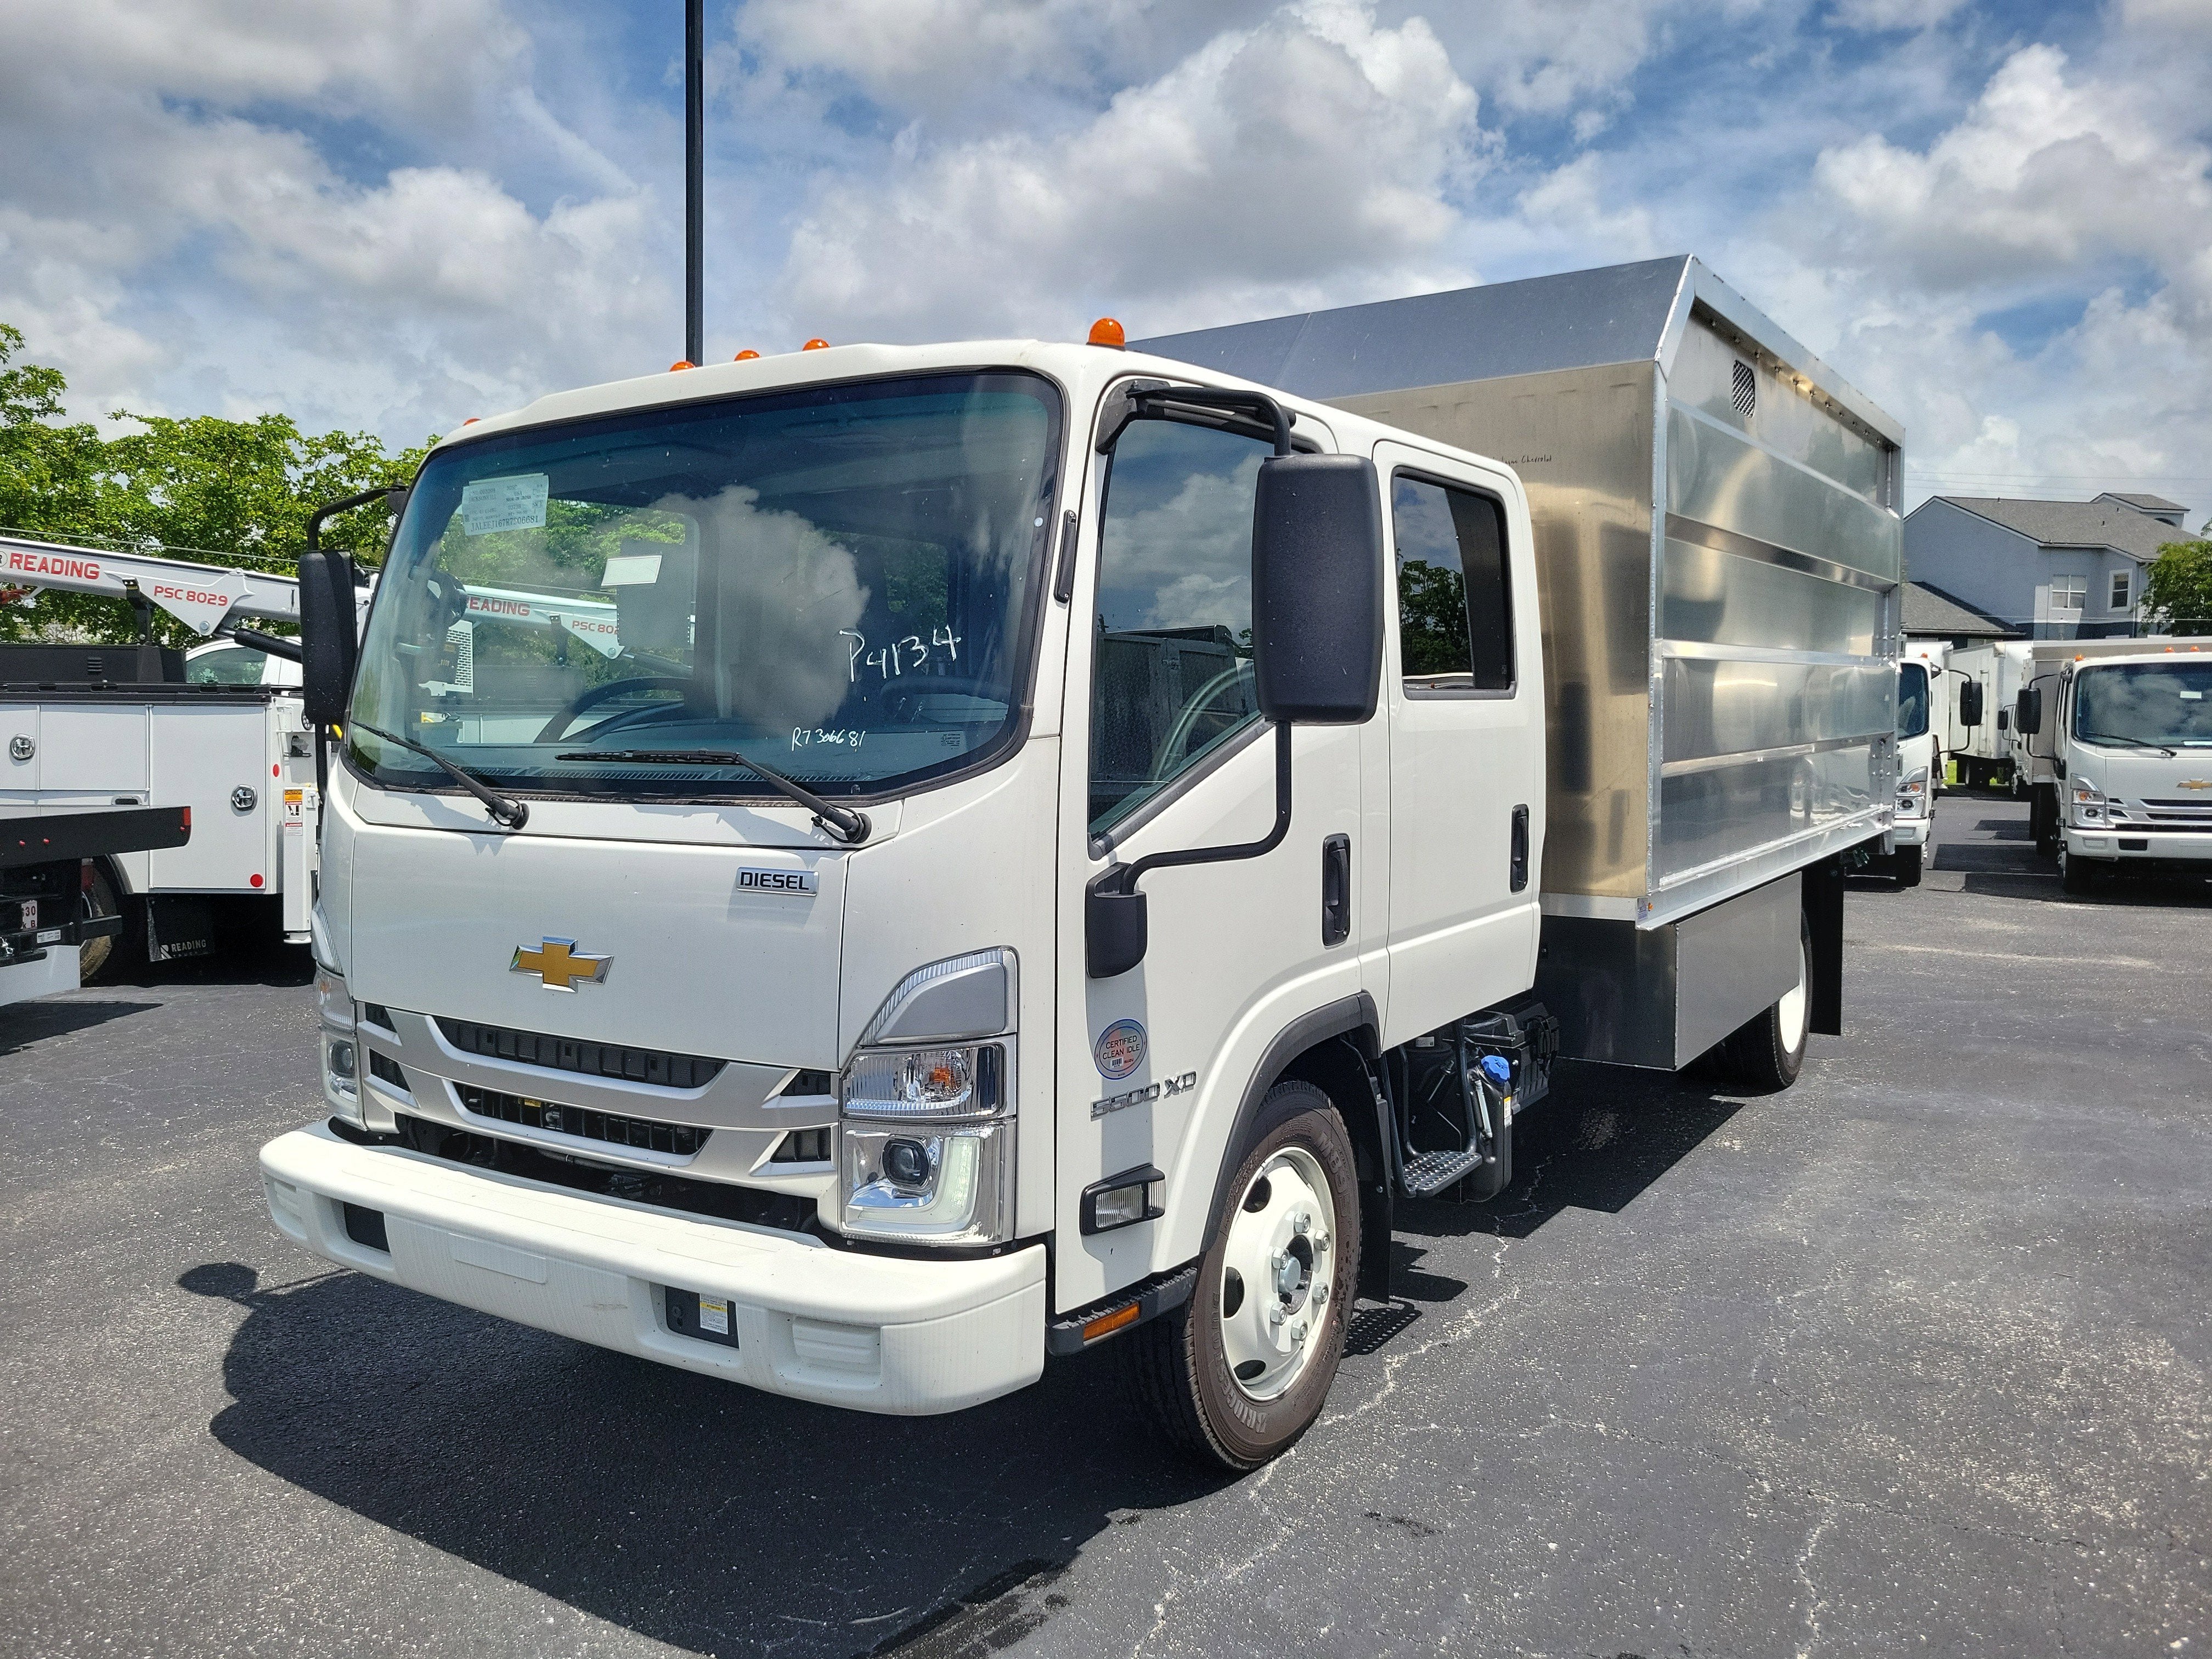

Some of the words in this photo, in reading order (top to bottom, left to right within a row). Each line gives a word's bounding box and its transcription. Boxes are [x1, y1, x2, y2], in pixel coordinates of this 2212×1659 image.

[9, 552, 100, 580] READING
[154, 585, 183, 600] PSC
[186, 590, 228, 606] 8029
[466, 596, 531, 616] EADING
[572, 620, 596, 631] PSC
[740, 872, 809, 890] DIESEL
[171, 939, 206, 952] READING
[1106, 1035, 1137, 1049] CERTIFIED
[1103, 1048, 1124, 1059] CLEAN
[1127, 1044, 1140, 1053] IDLE
[1091, 1082, 1160, 1119] 5500
[1164, 1071, 1197, 1098] XD
